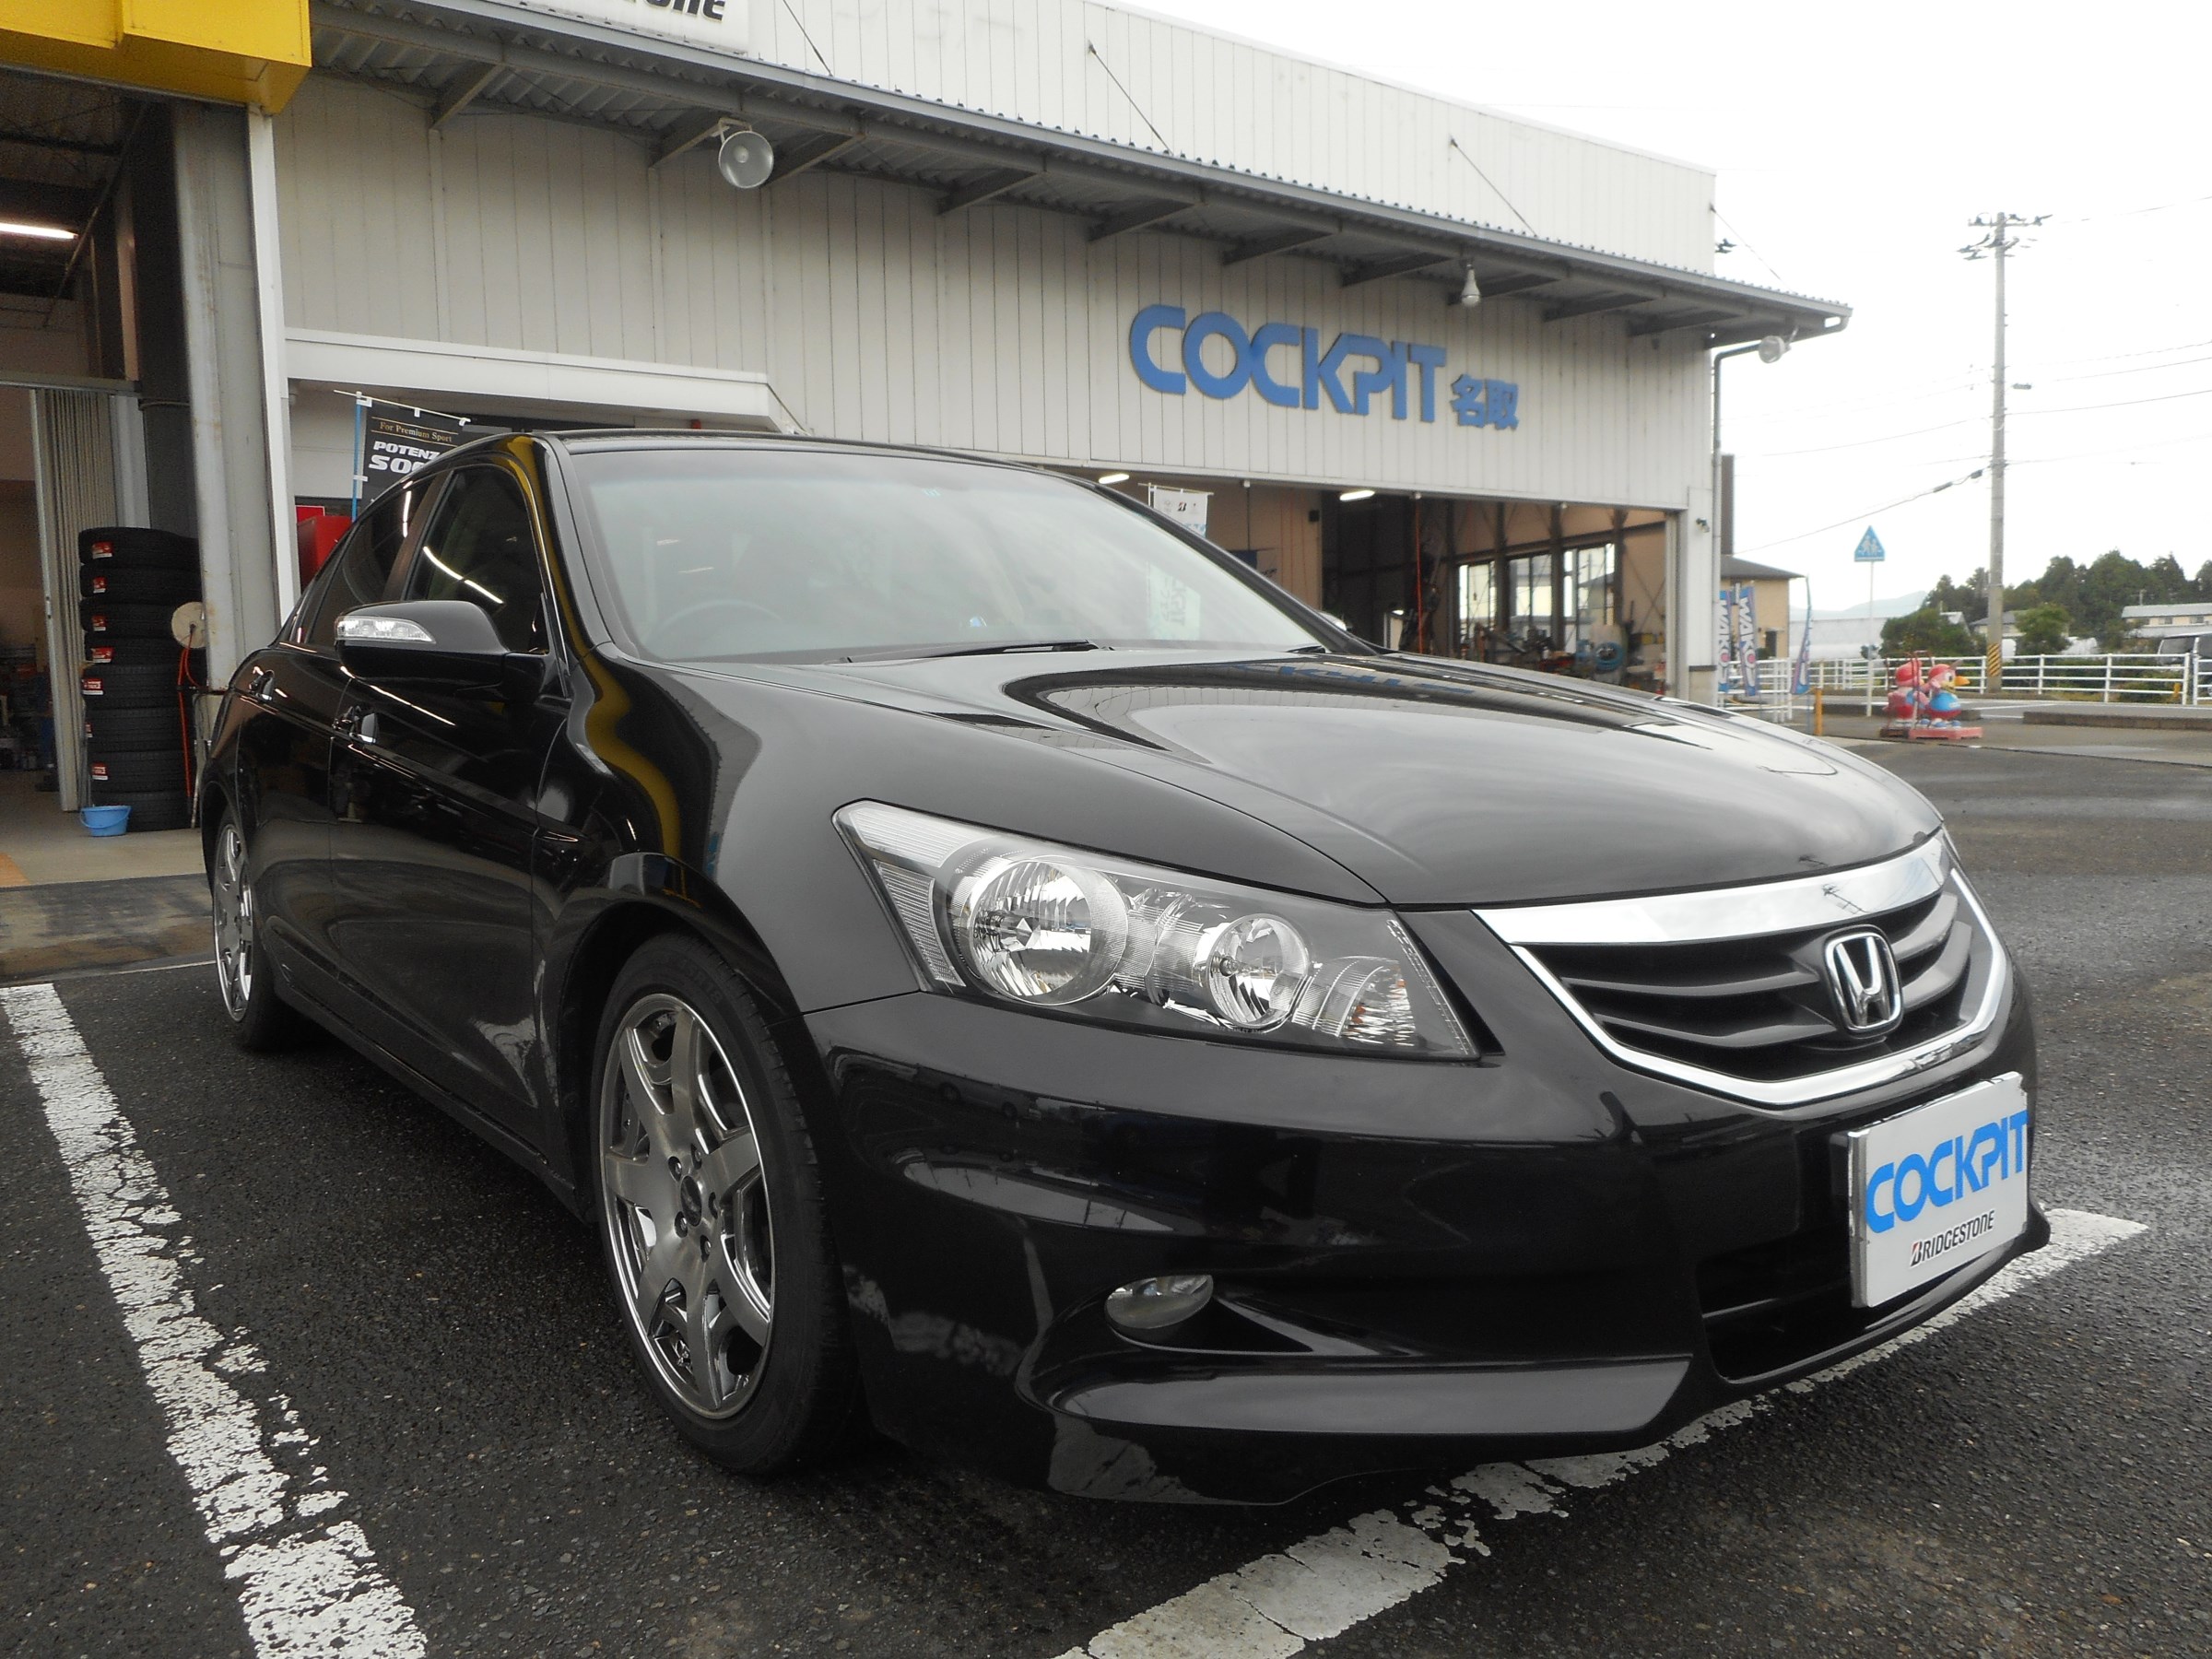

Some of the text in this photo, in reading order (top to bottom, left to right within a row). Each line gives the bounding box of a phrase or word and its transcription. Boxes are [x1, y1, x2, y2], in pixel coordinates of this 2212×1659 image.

[1129, 303, 1519, 430] COCKPIT 名取
[380, 422, 452, 442] For Premium Sport
[1865, 1109, 2029, 1233] COCKPIT
[1910, 1209, 1995, 1267] BRIDGESTONE
